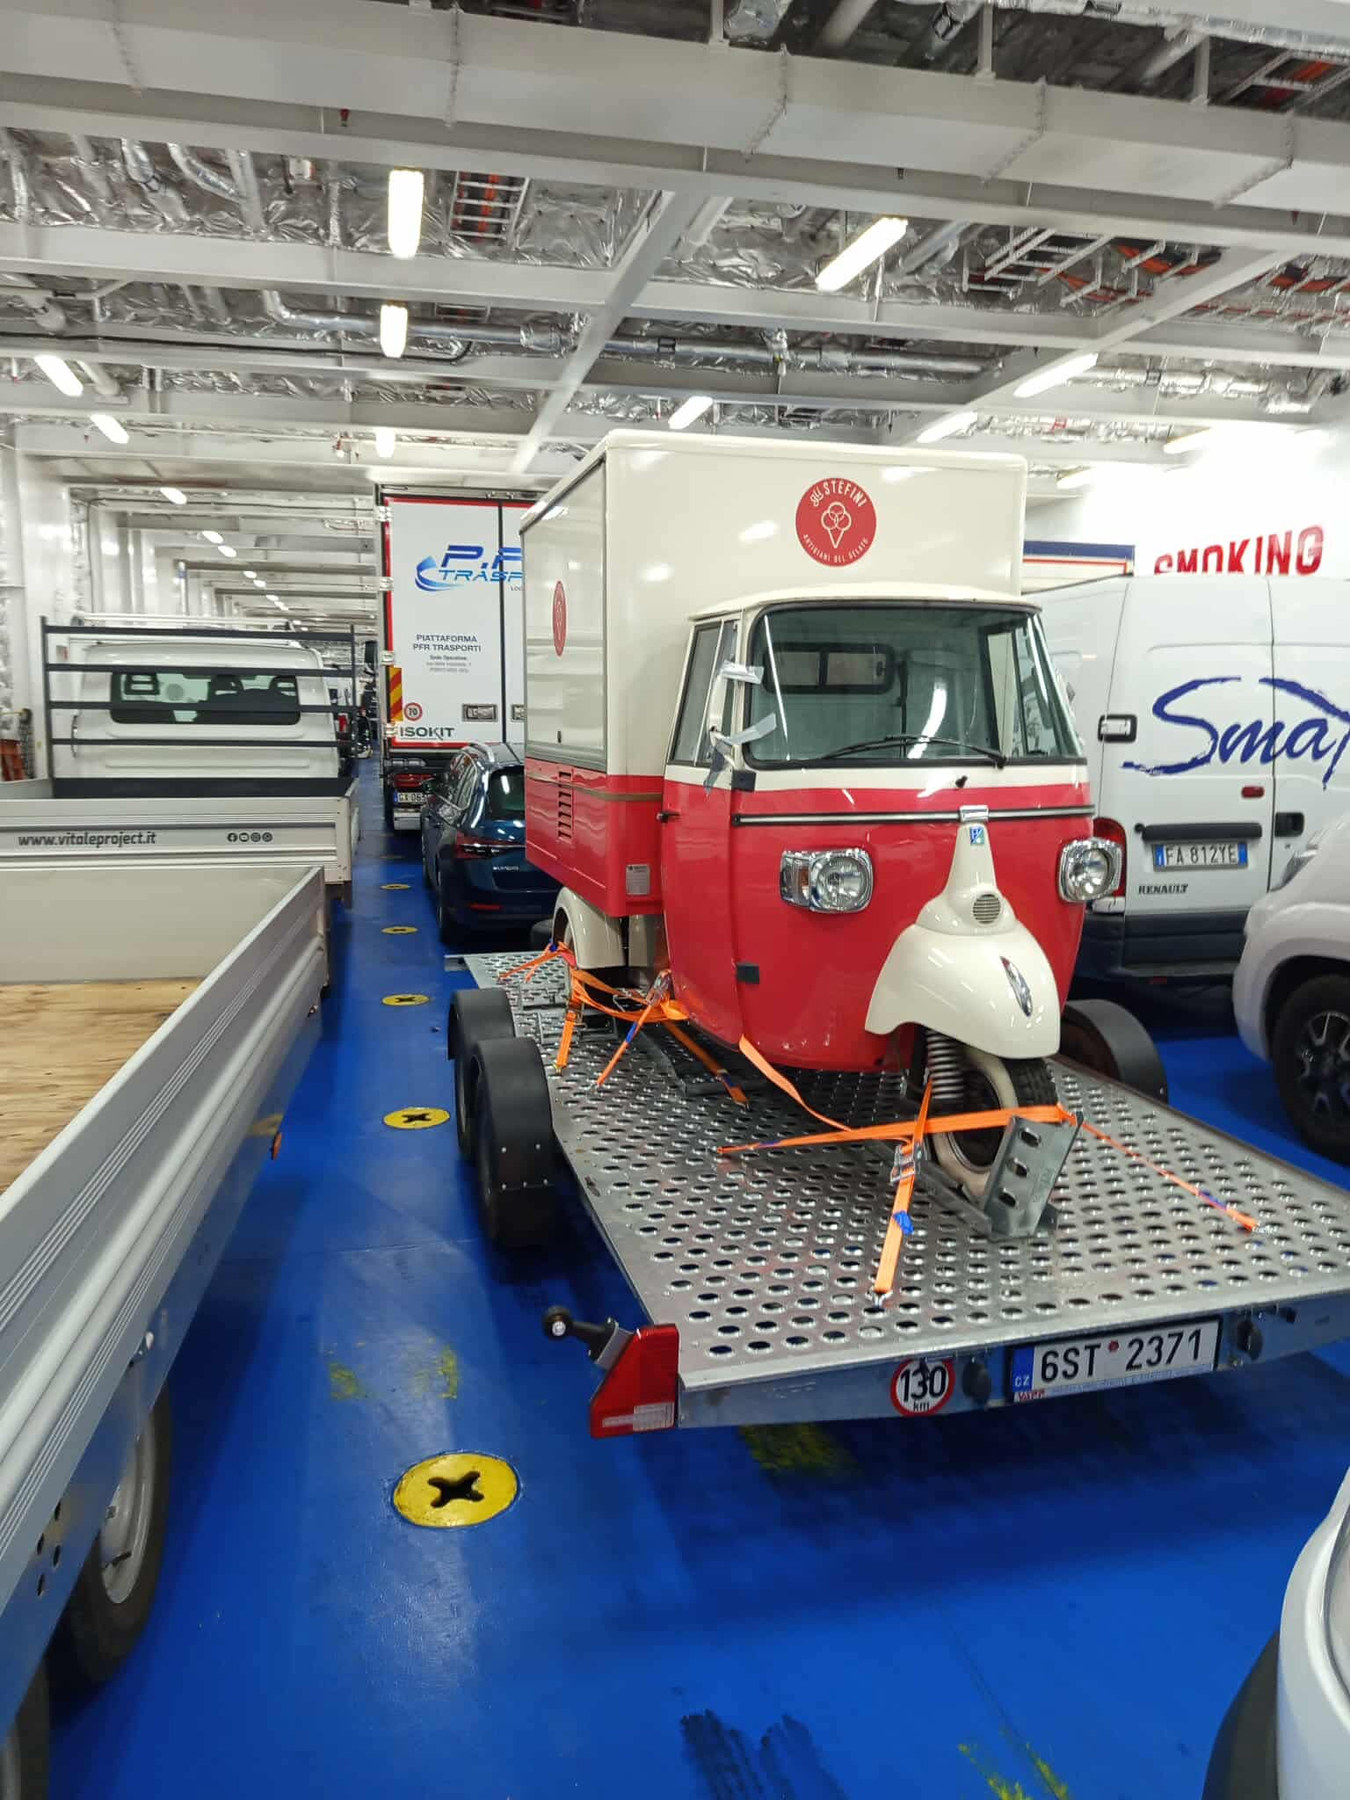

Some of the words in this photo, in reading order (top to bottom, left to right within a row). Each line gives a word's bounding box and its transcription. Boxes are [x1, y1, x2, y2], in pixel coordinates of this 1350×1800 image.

[823, 480, 868, 507] STEFINI
[1154, 526, 1324, 575] SMOKING
[416, 634, 478, 642] PIATTAFORMA
[413, 643, 431, 651] PFR
[432, 644, 482, 652] TRASPORTI
[400, 727, 455, 740] ISOKIT
[18, 831, 157, 848] www.vitaleproject.it
[1166, 847, 1184, 866] FA
[1190, 844, 1238, 866] 812YE
[1138, 883, 1189, 895] RENAULT
[1041, 1344, 1102, 1383] 6ST
[1126, 1329, 1201, 1371] 2371
[901, 1365, 947, 1402] 130
[1014, 1375, 1030, 1388] CZ
[913, 1401, 930, 1411] km
